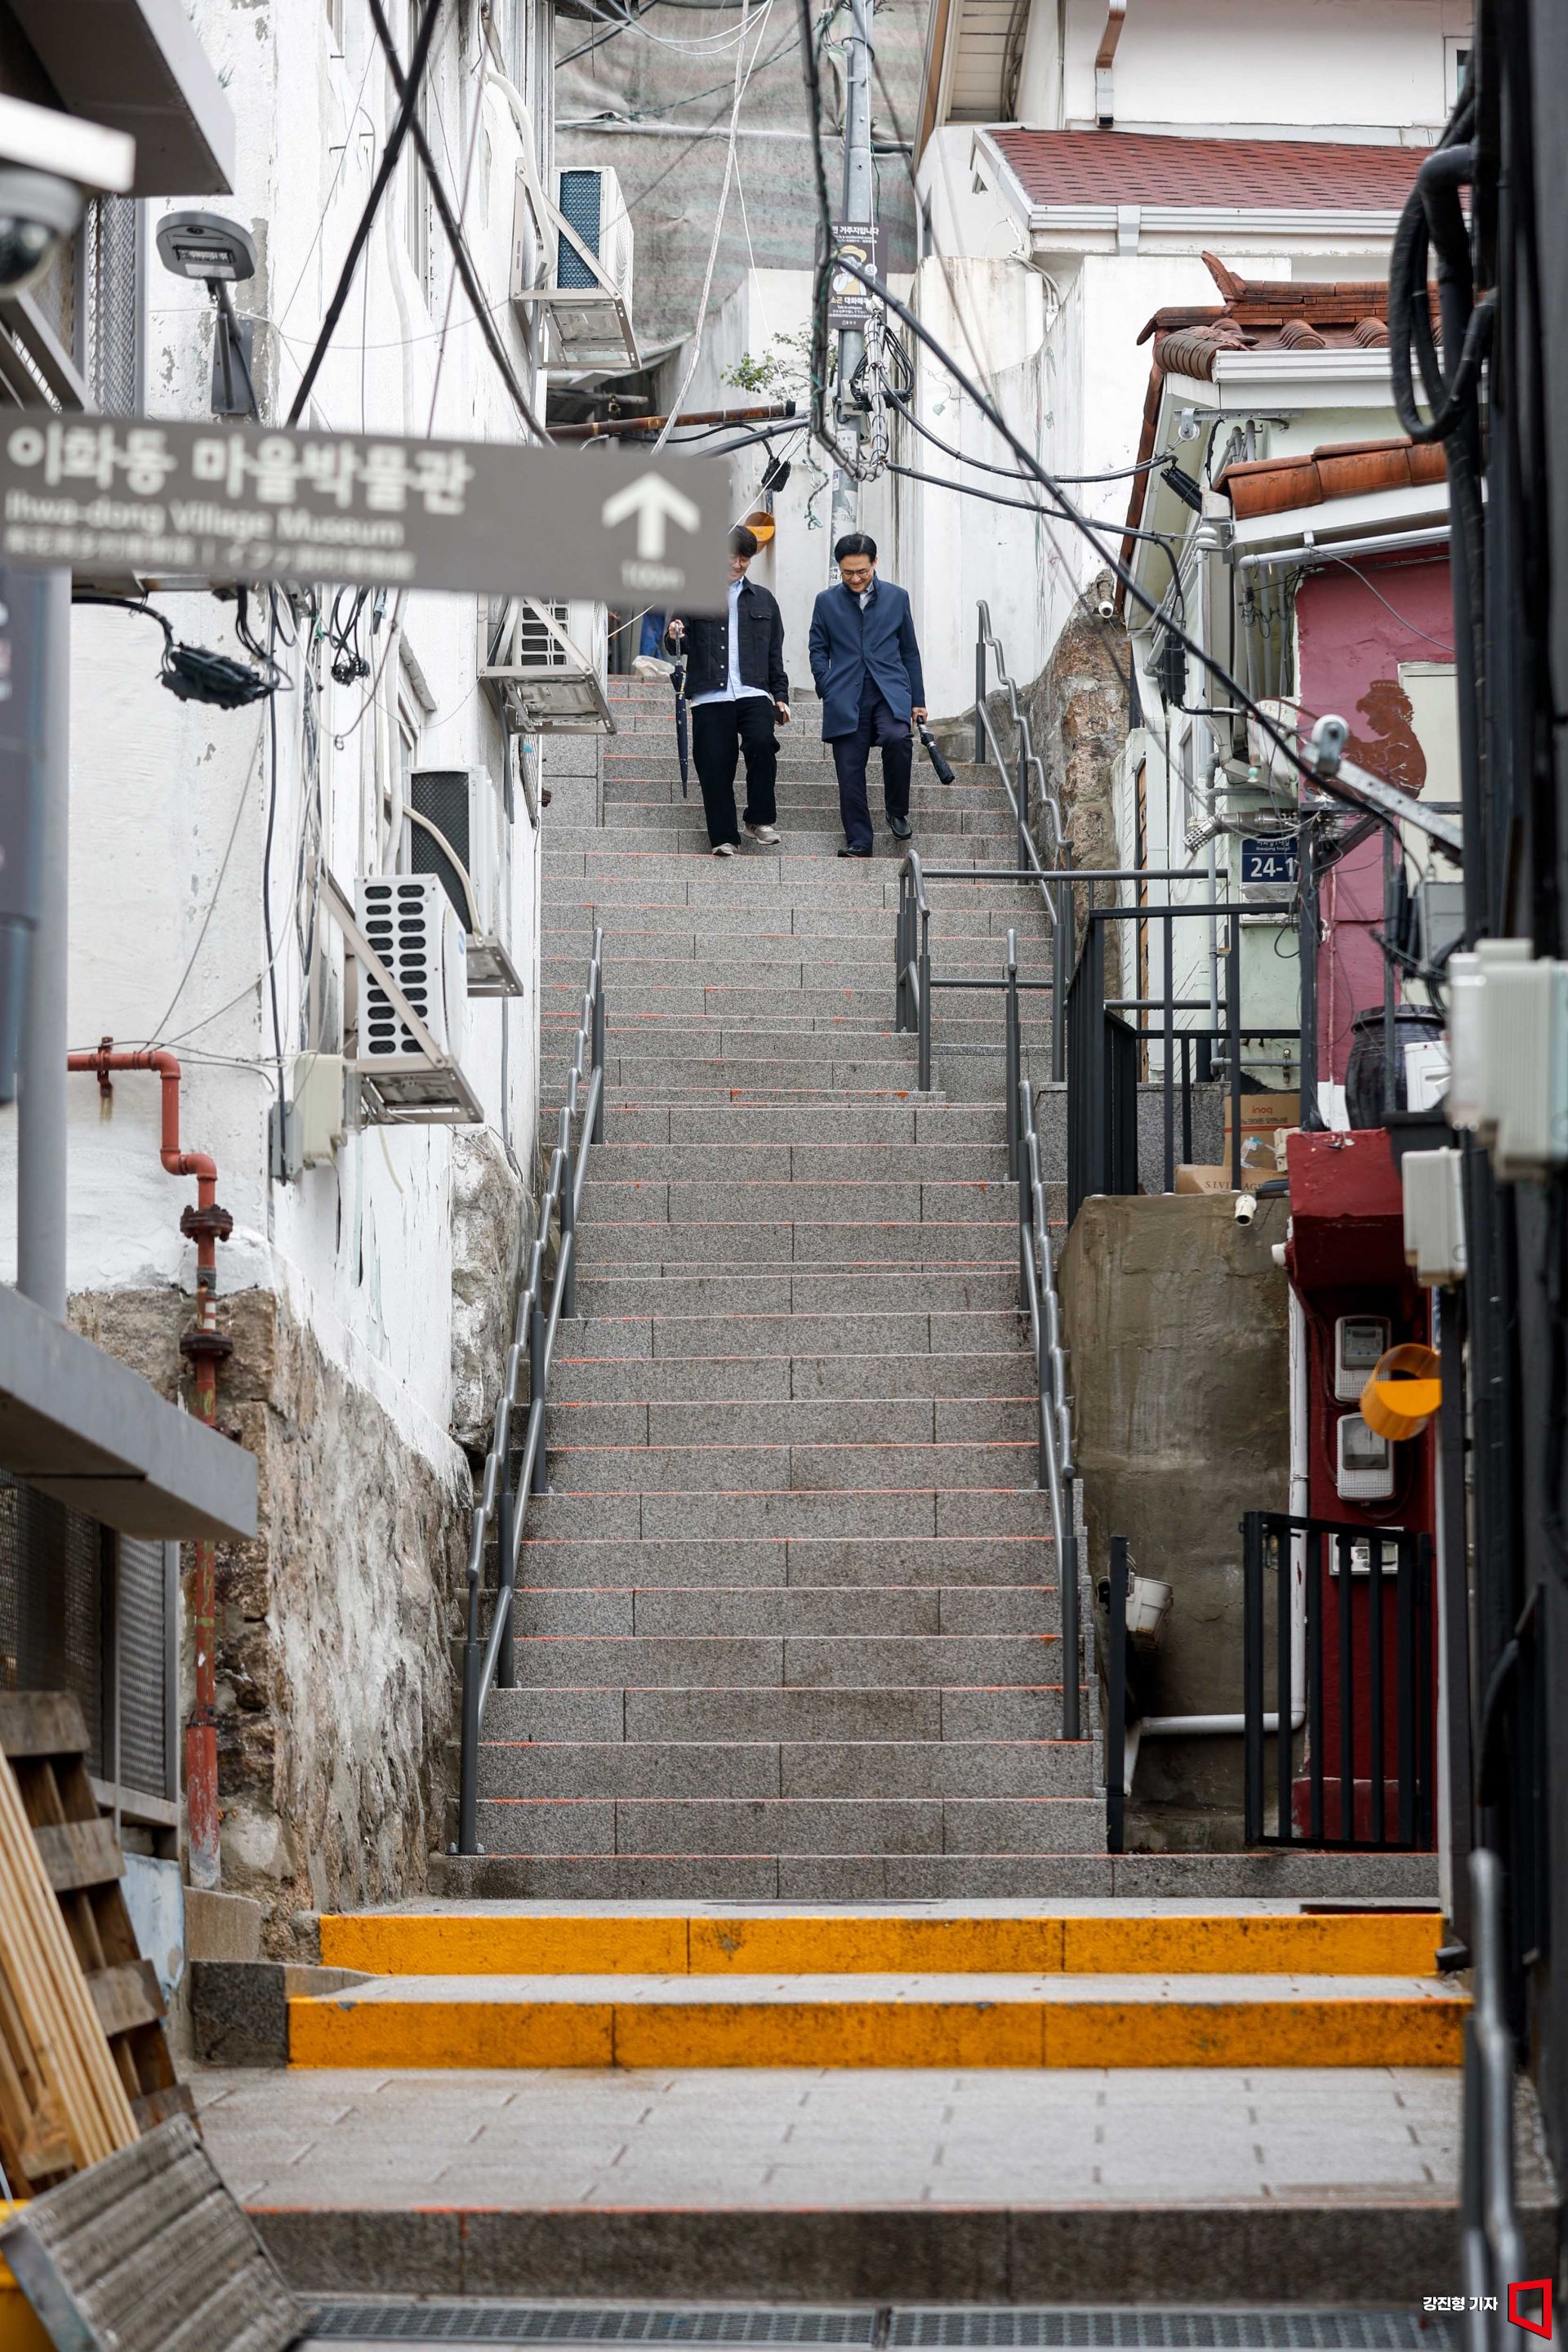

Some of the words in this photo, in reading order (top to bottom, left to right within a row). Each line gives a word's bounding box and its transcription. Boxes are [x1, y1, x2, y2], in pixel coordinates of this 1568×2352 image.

[840, 226, 880, 235] 거주지입니다
[7, 420, 177, 495] 이화동
[192, 432, 475, 515] 마을박물관
[169, 499, 274, 545] Village
[277, 506, 405, 548] Museum
[1250, 857, 1294, 878] 24-1
